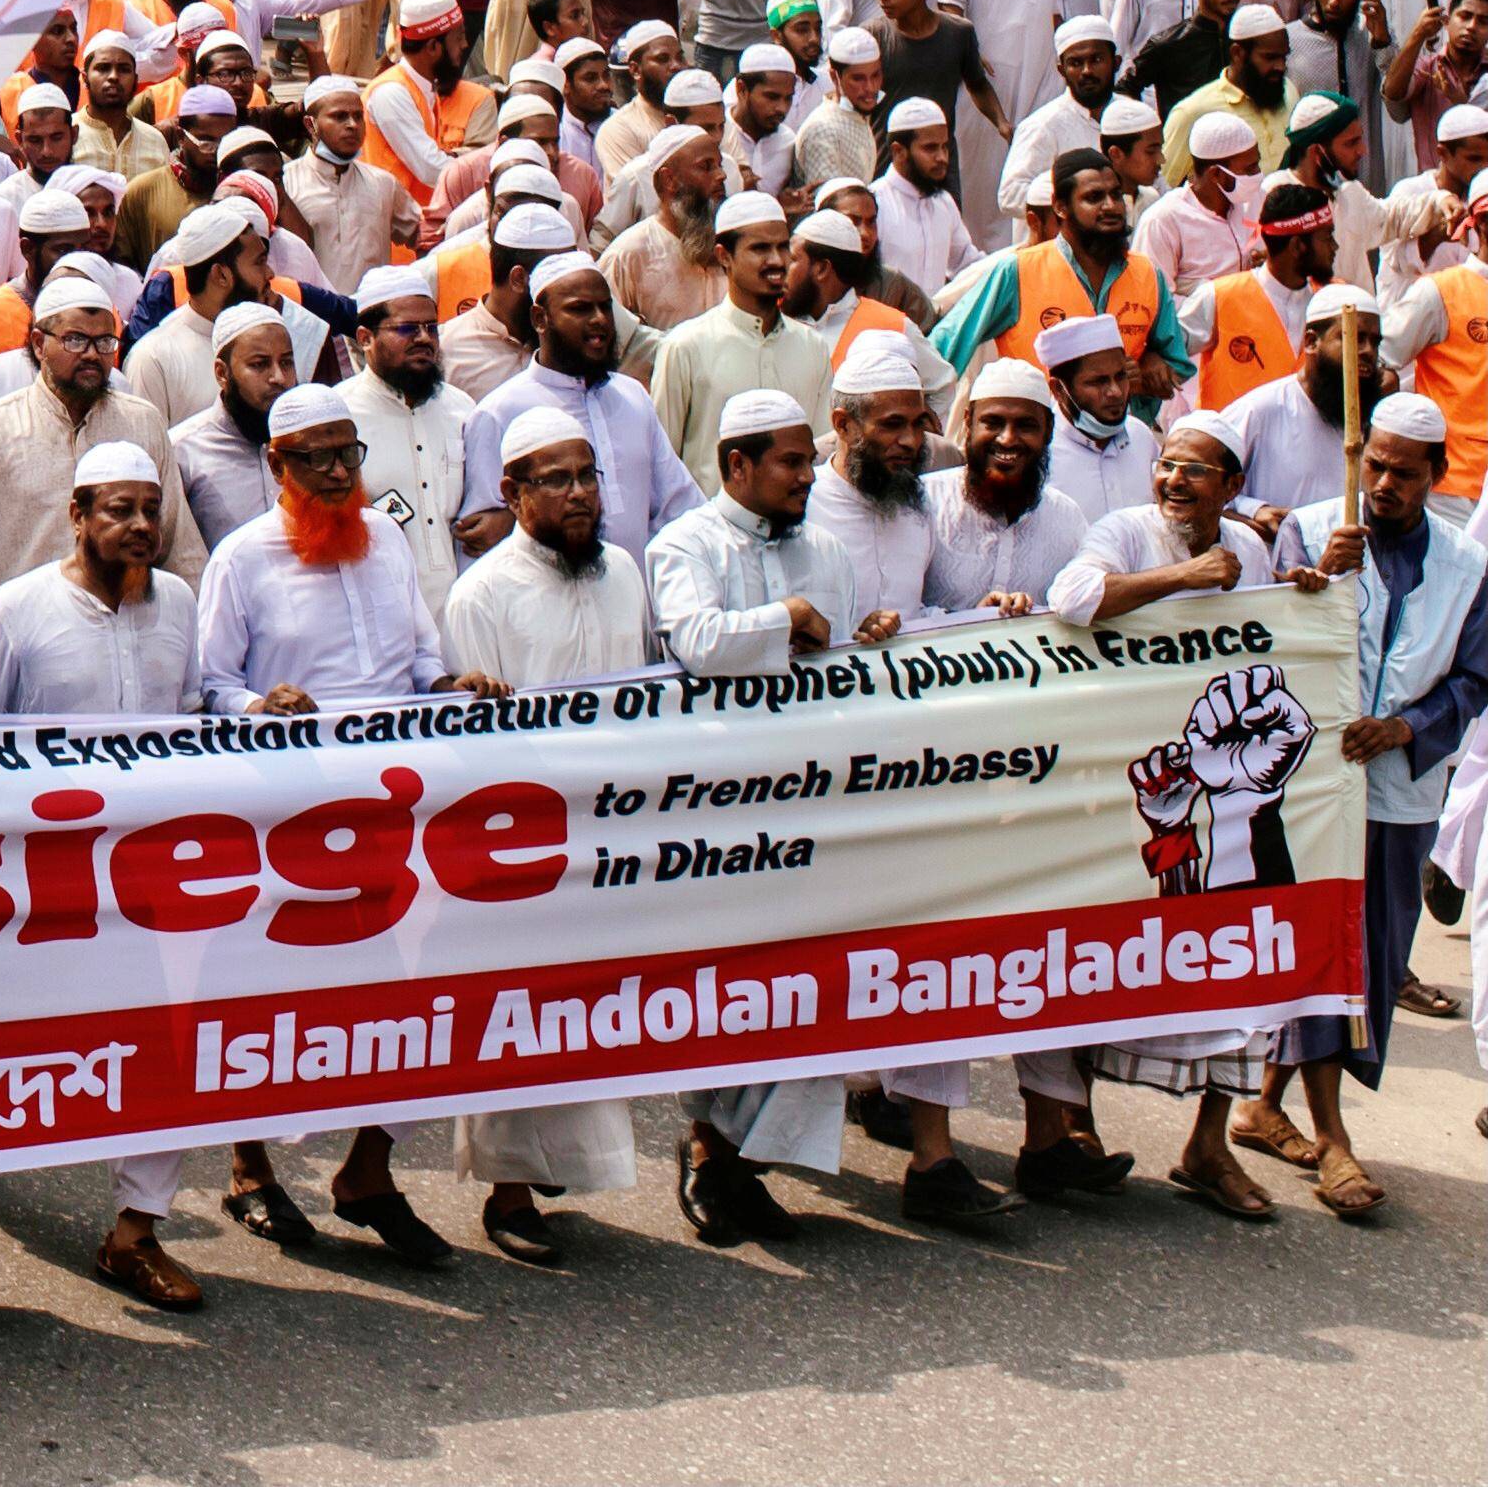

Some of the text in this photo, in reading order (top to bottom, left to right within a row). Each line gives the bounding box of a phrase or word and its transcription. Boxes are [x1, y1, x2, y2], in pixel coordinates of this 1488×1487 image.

[35, 713, 320, 773] Exposition
[334, 685, 599, 746] caricature
[612, 677, 673, 723] of
[678, 659, 876, 721] Prophet
[885, 636, 1040, 702] (pbuh)
[1041, 630, 1097, 674] in
[1098, 616, 1274, 668] France
[593, 740, 1061, 819] to French Embassy
[593, 830, 815, 890] in Dhaka
[195, 904, 1298, 1095] Islami Andolan Bangladesh
